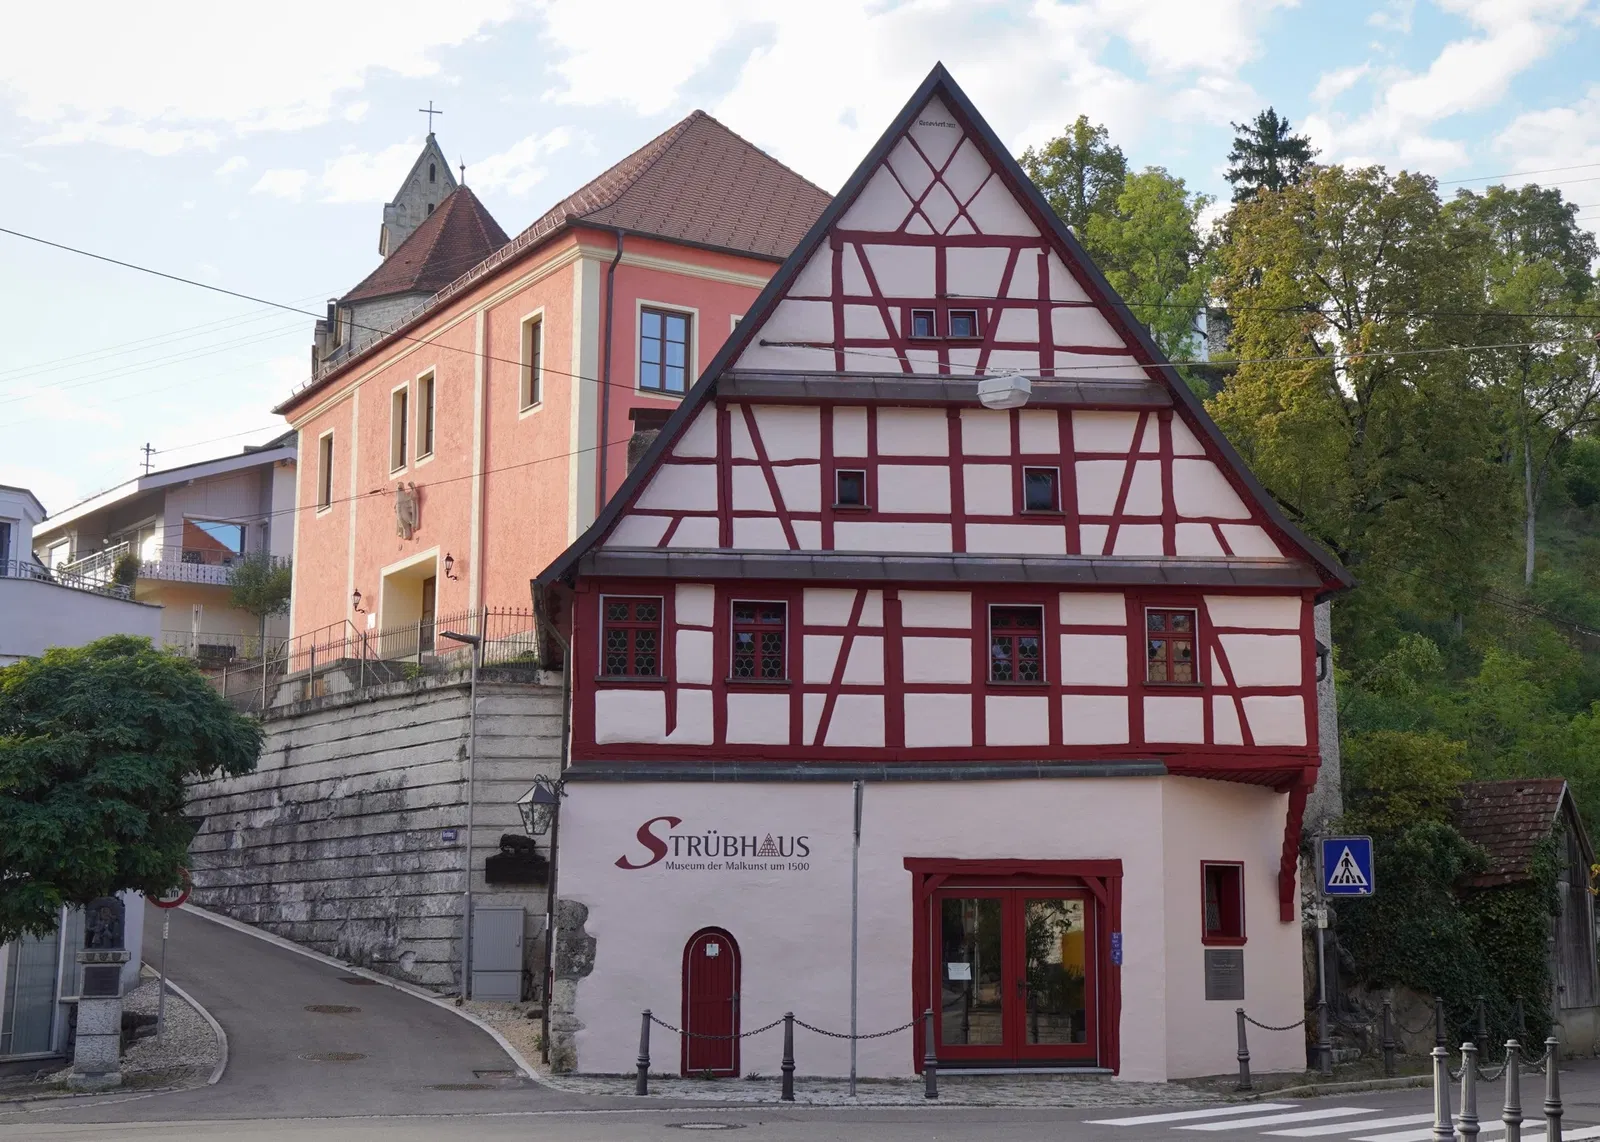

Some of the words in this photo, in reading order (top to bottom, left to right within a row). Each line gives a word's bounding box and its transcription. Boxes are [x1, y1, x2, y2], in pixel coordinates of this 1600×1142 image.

[665, 861, 705, 870] Museum
[707, 861, 722, 871] der
[725, 861, 768, 871] Malkunst
[770, 863, 785, 871] um
[788, 862, 810, 871] 1500
